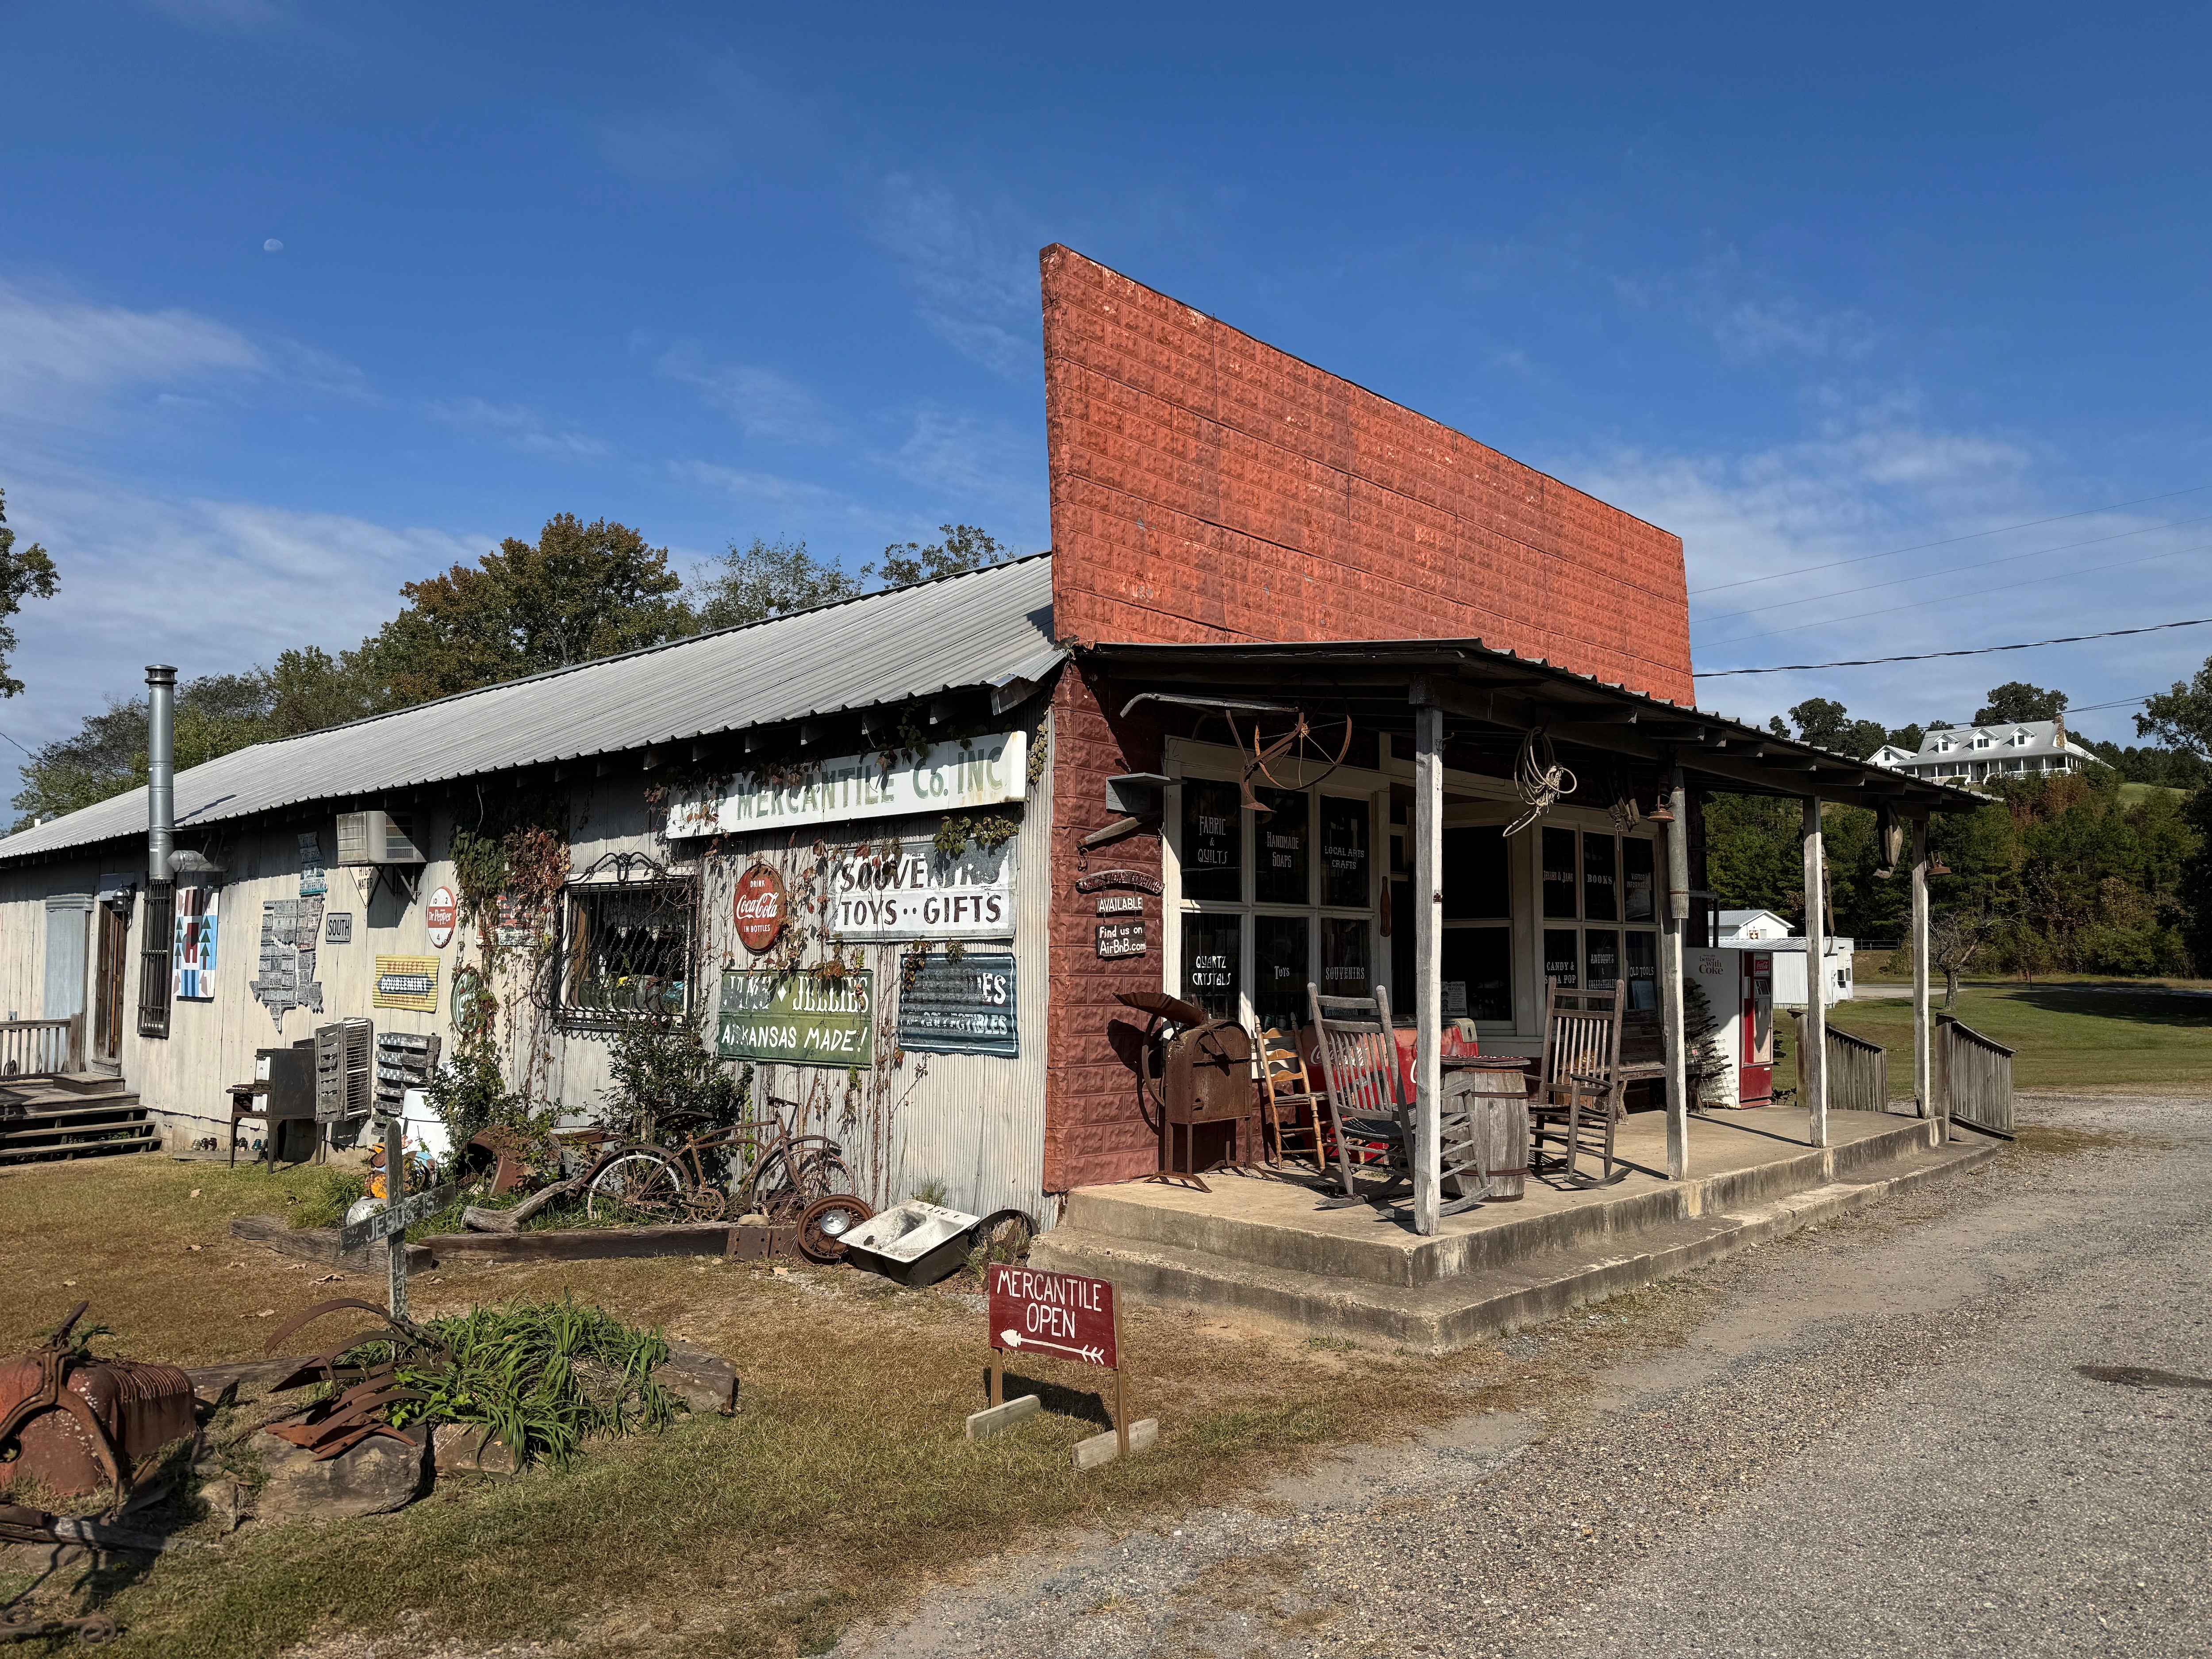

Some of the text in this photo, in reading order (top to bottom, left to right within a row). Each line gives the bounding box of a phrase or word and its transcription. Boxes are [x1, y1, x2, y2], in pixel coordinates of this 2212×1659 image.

[737, 764, 896, 820] MERCANTILE
[958, 746, 1003, 794] INC
[1199, 815, 1226, 836] FABRIC
[1210, 837, 1215, 846] &
[1267, 832, 1299, 849] HANDMADE
[1198, 848, 1228, 864] QUILTS
[1325, 845, 1365, 858] LOCAL ARTS
[1272, 852, 1292, 868] SOAPS
[1332, 860, 1357, 869] CRAFTS
[358, 878, 373, 890] WATER
[1083, 872, 1162, 892] VACATION LODGING
[1587, 874, 1613, 884] BOOKS
[841, 894, 1002, 926] TOYS GIFTS
[1098, 897, 1143, 912] AVAILABLE
[434, 909, 452, 925] Pepper
[328, 919, 350, 936] SOUTH
[750, 924, 771, 933] BOTTLES
[1120, 927, 1130, 936] us
[1099, 938, 1146, 955] AirBnB.com
[1196, 956, 1226, 969] QUARTZ
[1547, 961, 1575, 971] CANDY &
[1591, 954, 1614, 964] ANTIQUES
[1326, 967, 1365, 980] SOUVENIRS
[1629, 966, 1654, 977] OLD TOOLS
[1699, 964, 1723, 975] Coke
[381, 977, 427, 991] DOUBLEMINT
[1193, 972, 1231, 986] CRYSTALS
[1545, 975, 1576, 984] SA POP
[792, 975, 869, 1013] JELLIES
[997, 1270, 1102, 1312] MERCANTILE
[1026, 1302, 1075, 1339] OPEN
